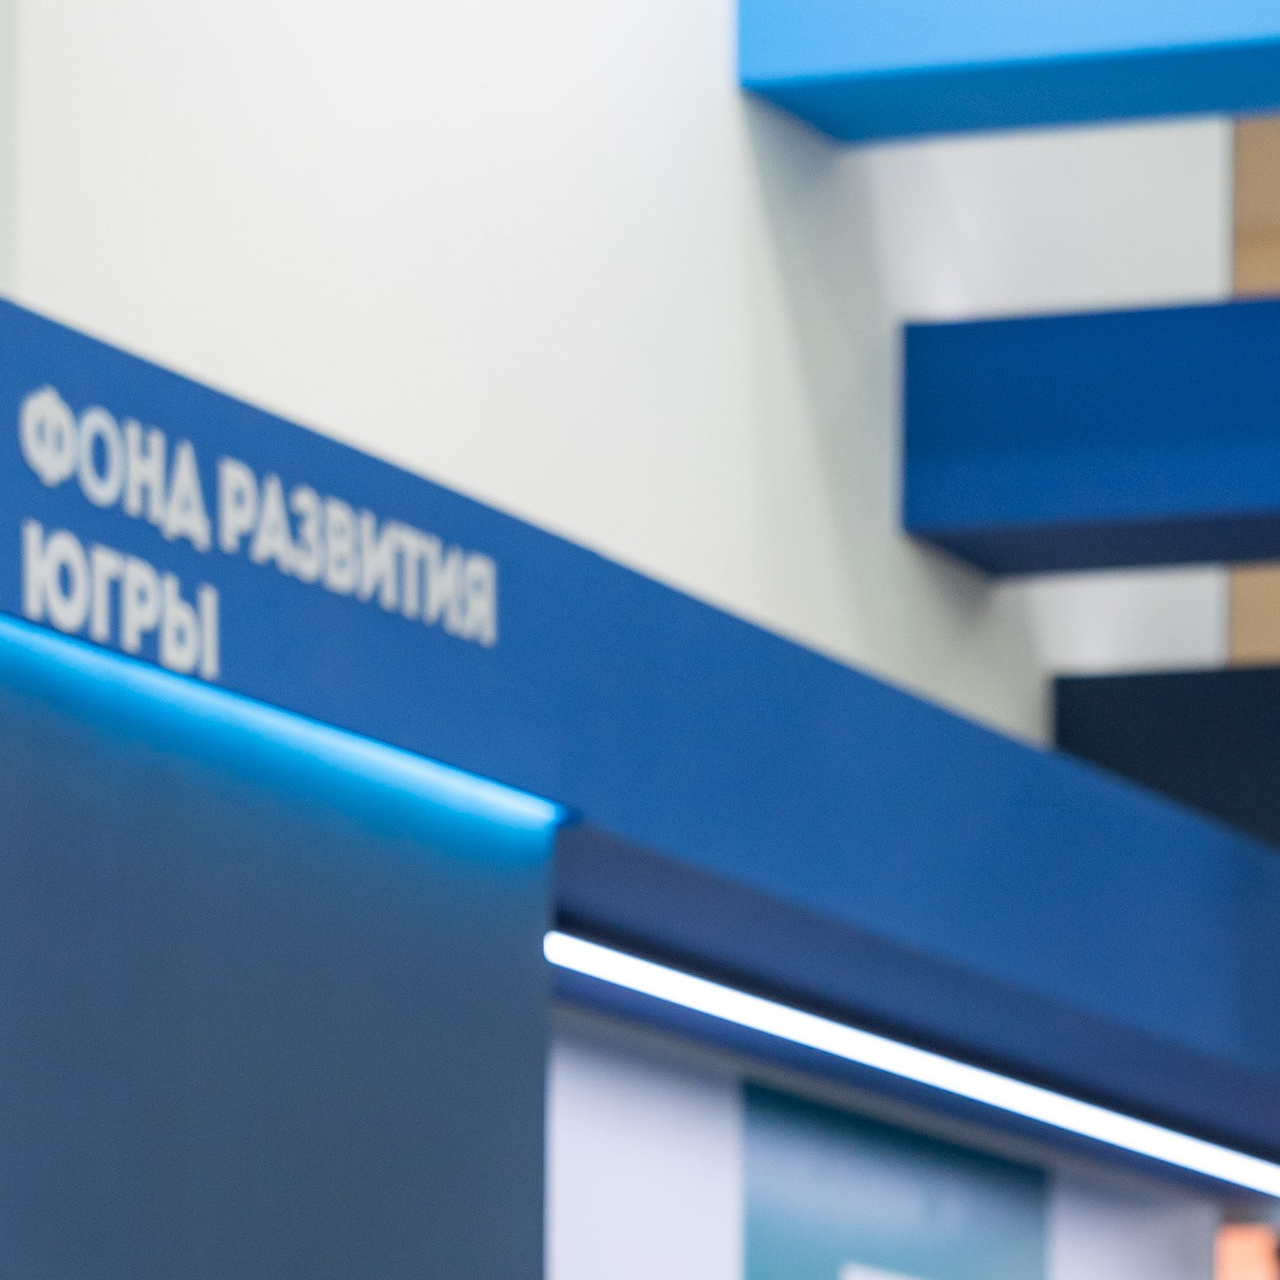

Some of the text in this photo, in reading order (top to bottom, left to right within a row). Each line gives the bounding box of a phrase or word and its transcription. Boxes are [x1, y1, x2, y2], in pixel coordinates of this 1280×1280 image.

[20, 385, 499, 649] ФОНД РАЗВИТИЯ
[22, 518, 220, 680] ЮГРЫ
